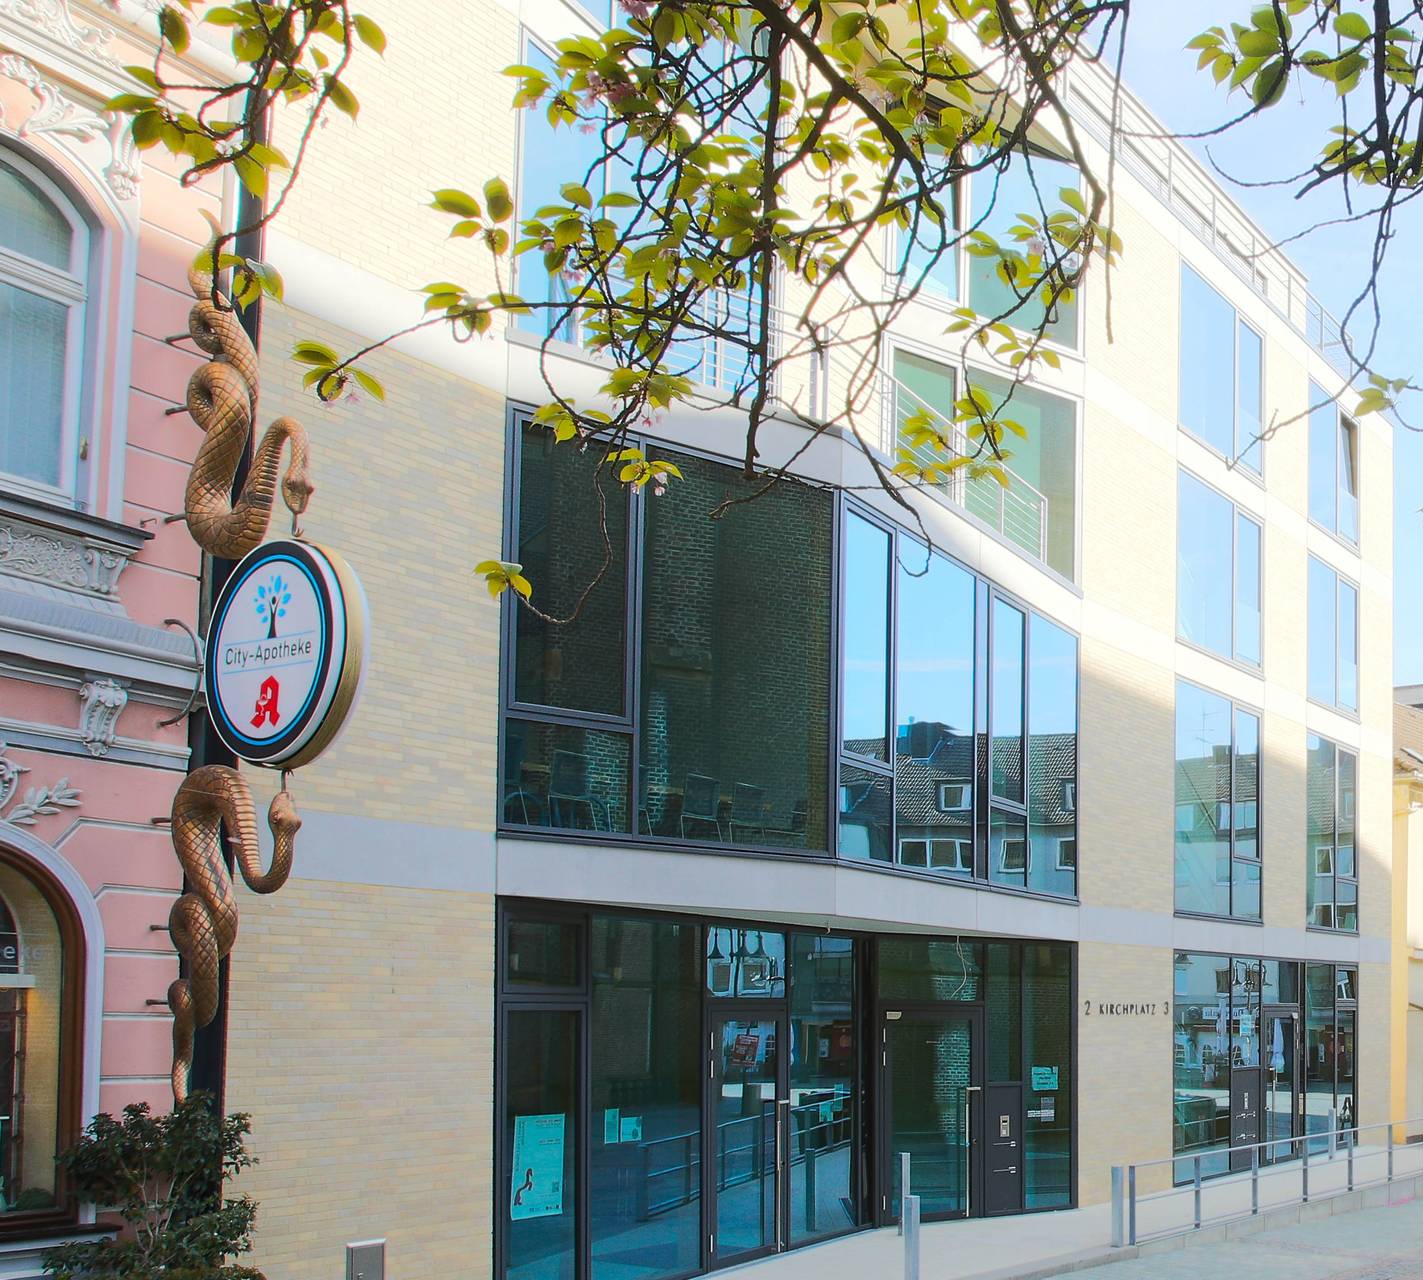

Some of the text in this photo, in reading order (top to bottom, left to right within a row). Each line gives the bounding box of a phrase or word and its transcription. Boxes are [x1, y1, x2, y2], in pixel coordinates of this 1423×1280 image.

[225, 639, 312, 668] City-Apotheke
[1084, 1000, 1169, 1016] 2 KIRCHPLATZ 3
